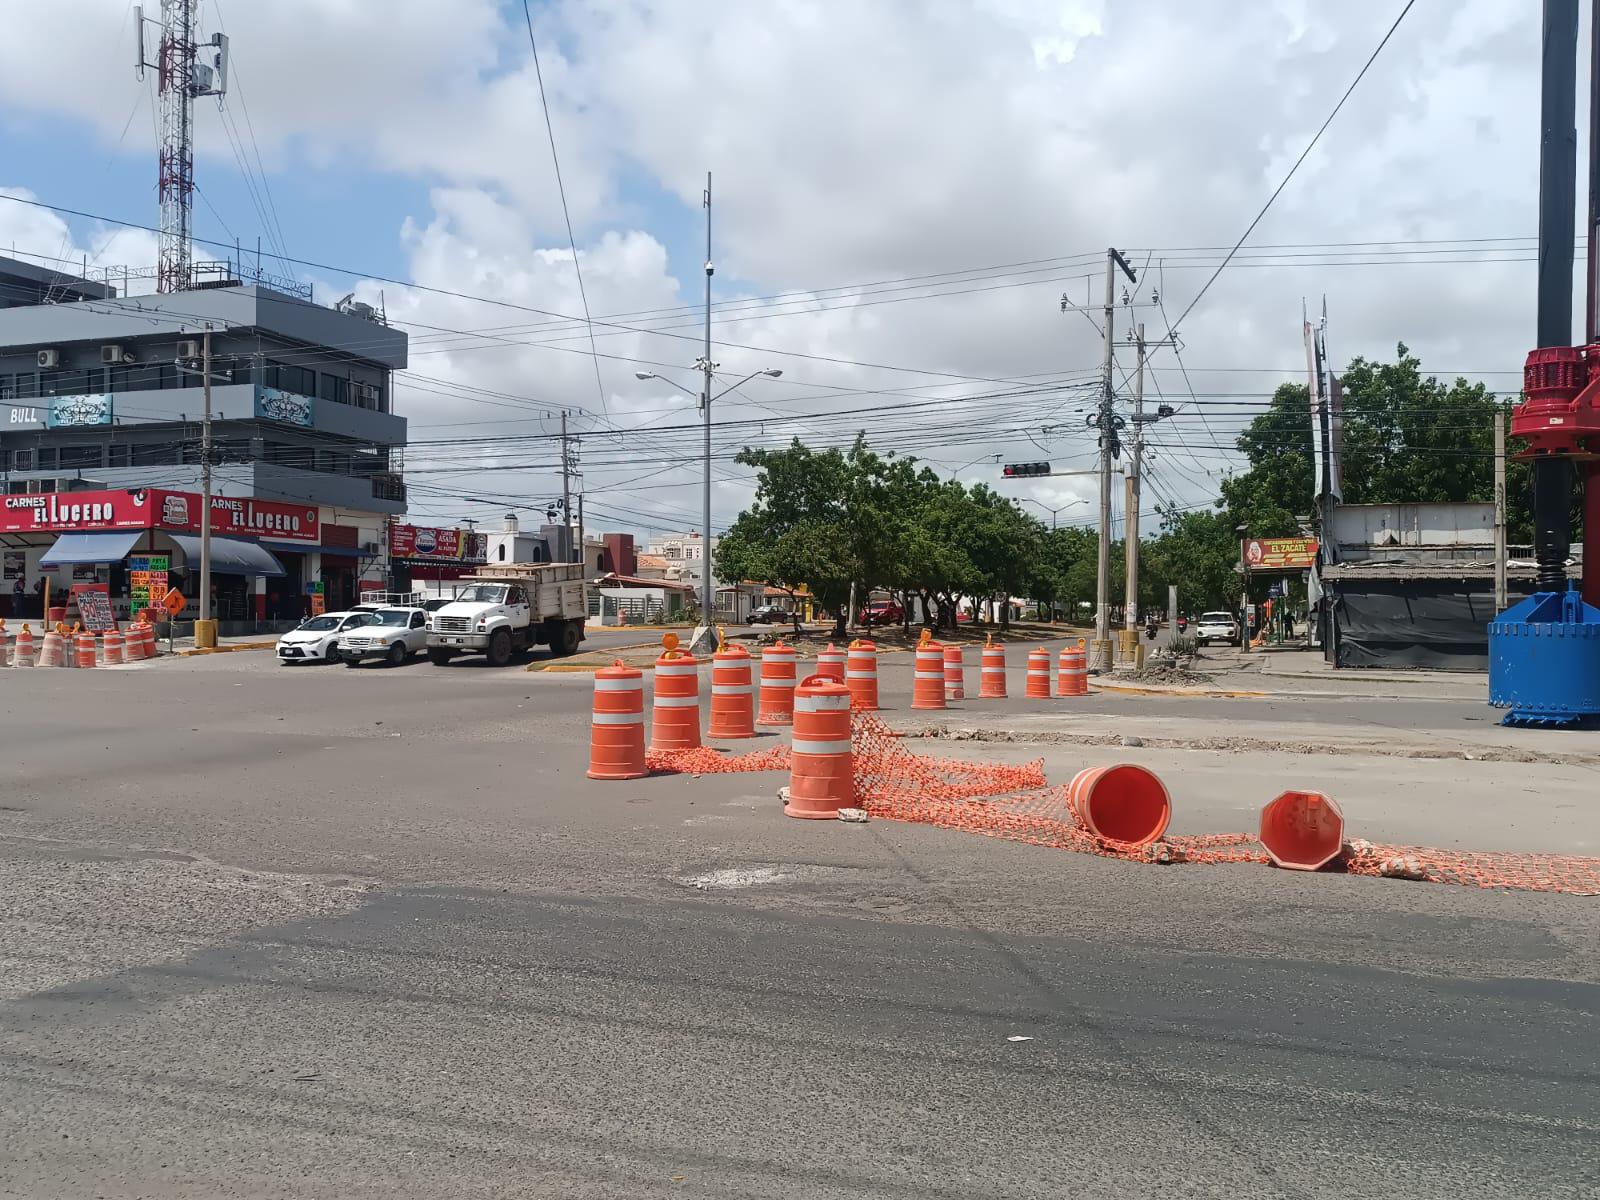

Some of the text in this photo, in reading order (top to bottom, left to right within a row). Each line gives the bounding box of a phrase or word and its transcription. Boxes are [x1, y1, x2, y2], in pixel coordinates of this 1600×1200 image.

[10, 408, 37, 424] BULL
[5, 497, 46, 508] CARNES
[34, 495, 113, 523] EL LUCERO
[210, 498, 243, 511] ARNES
[233, 501, 300, 531] EL LUCERO
[1271, 544, 1306, 553] EL ZACATE
